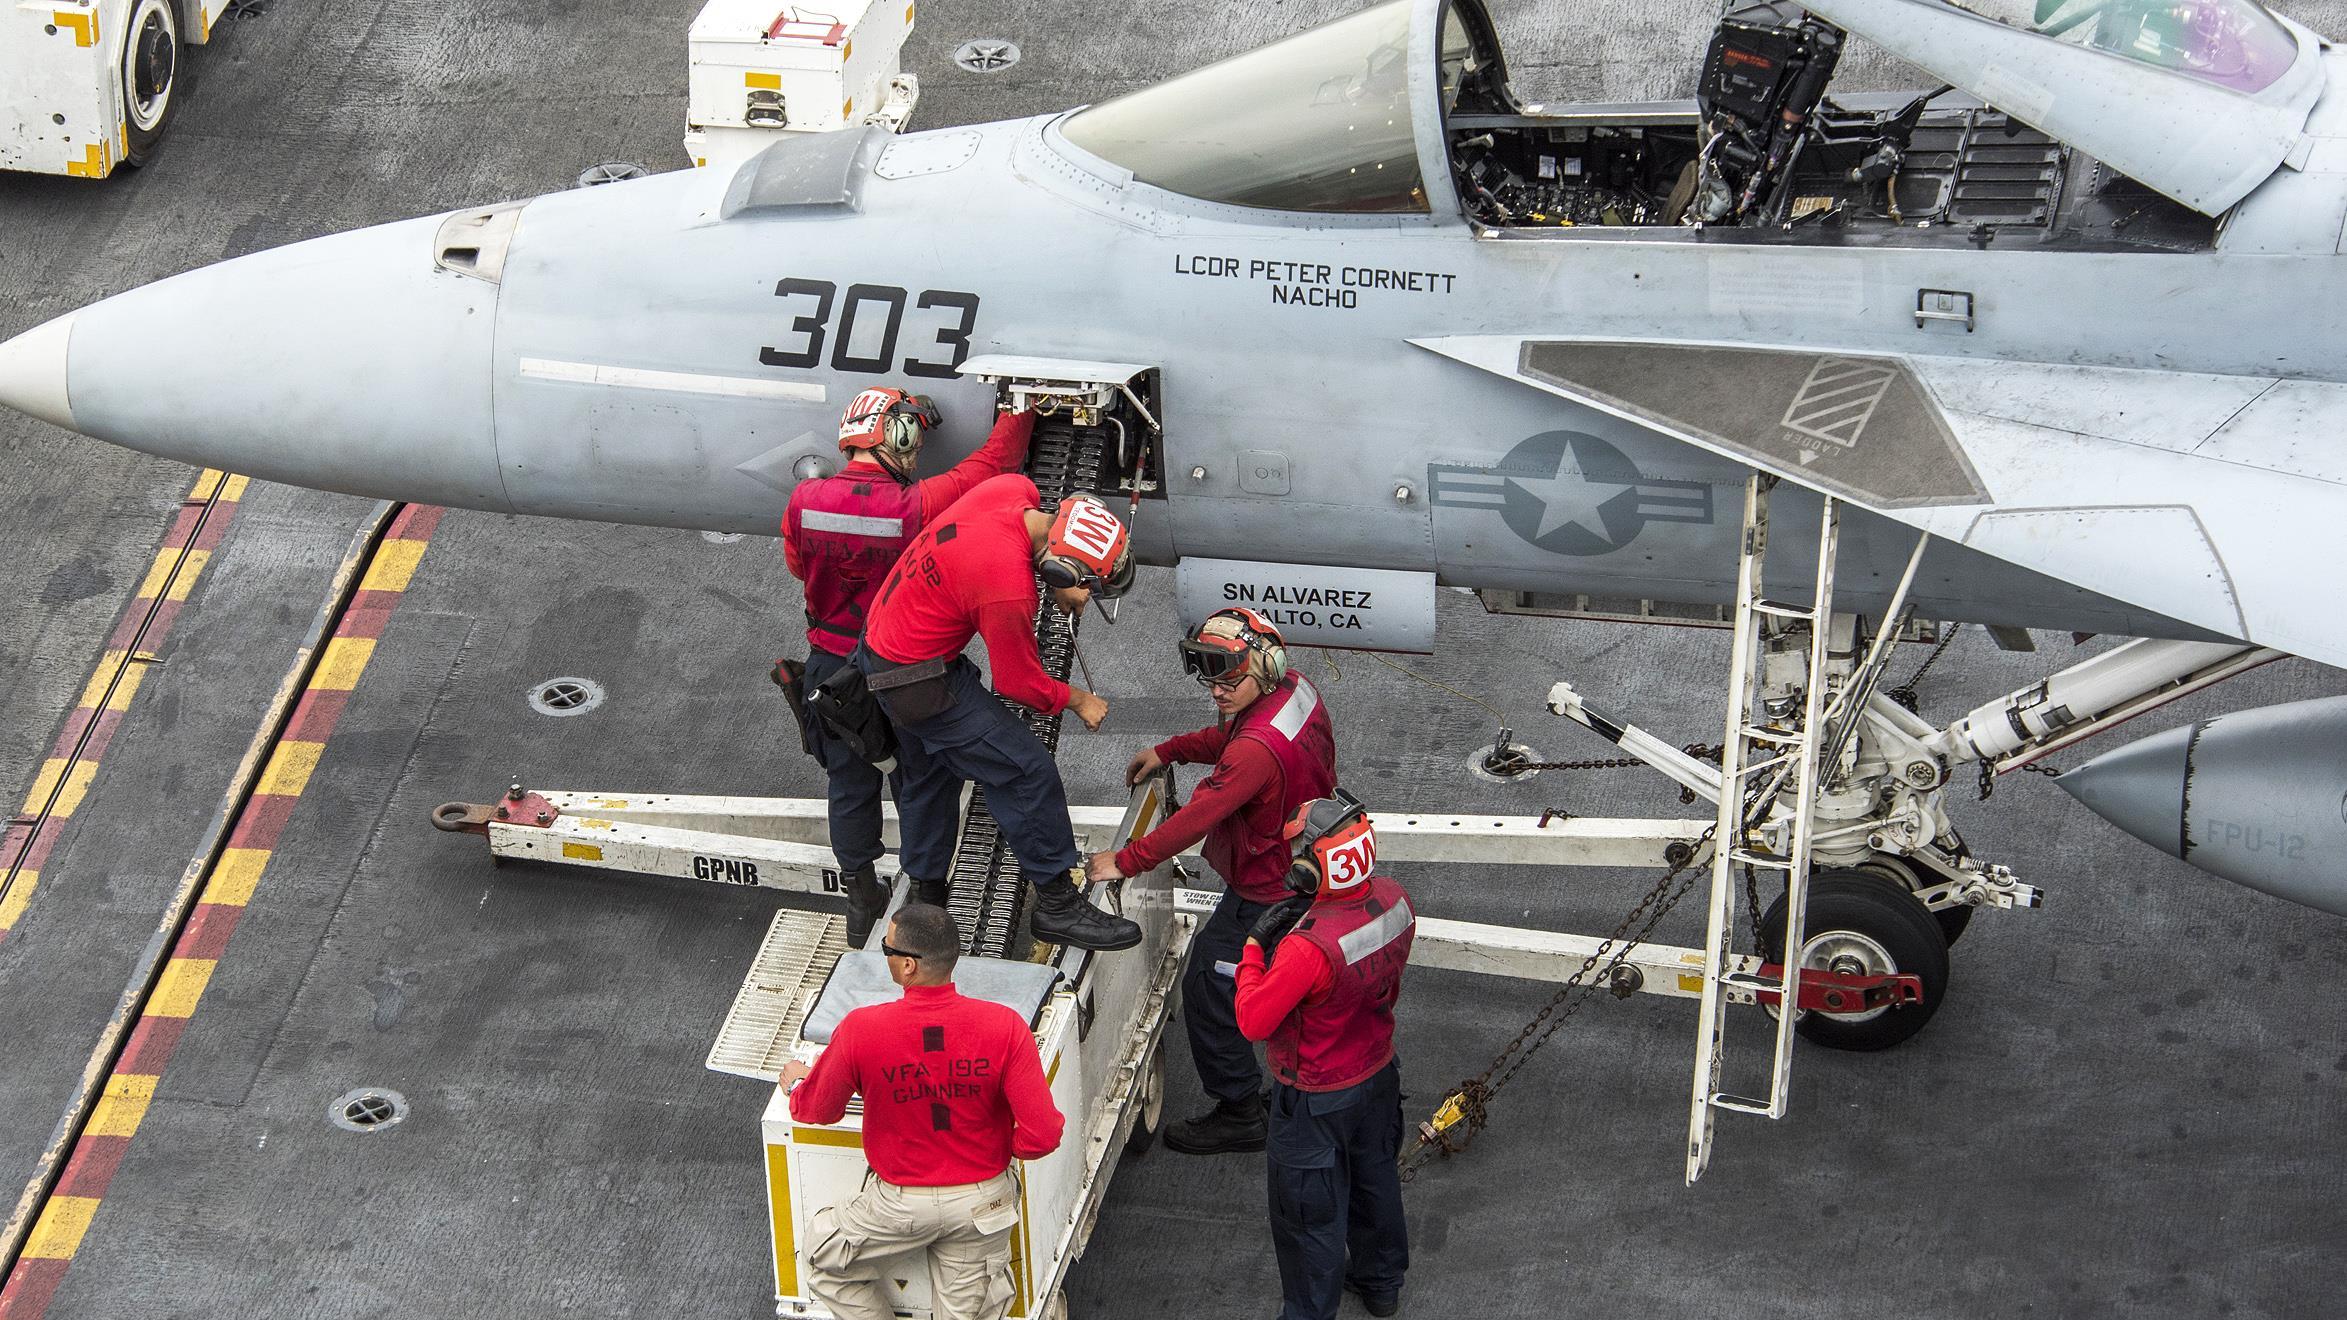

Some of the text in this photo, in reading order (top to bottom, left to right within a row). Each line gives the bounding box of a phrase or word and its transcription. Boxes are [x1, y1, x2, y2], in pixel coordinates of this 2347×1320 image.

[1176, 254, 1456, 293] LCDR PETER CORNETT
[1273, 284, 1356, 309] NACHO
[759, 277, 980, 379] 303
[1783, 432, 1841, 456] LADDER
[1072, 506, 1116, 554] 3W
[1223, 583, 1372, 609] SN ALVAREZ
[1252, 608, 1362, 630] ALTO, CA
[693, 856, 758, 886] GPNB
[1331, 836, 1376, 884] 3W
[1183, 891, 1209, 900] STOW
[1186, 897, 1211, 906] WHEN
[894, 1084, 981, 1105] GUNNER
